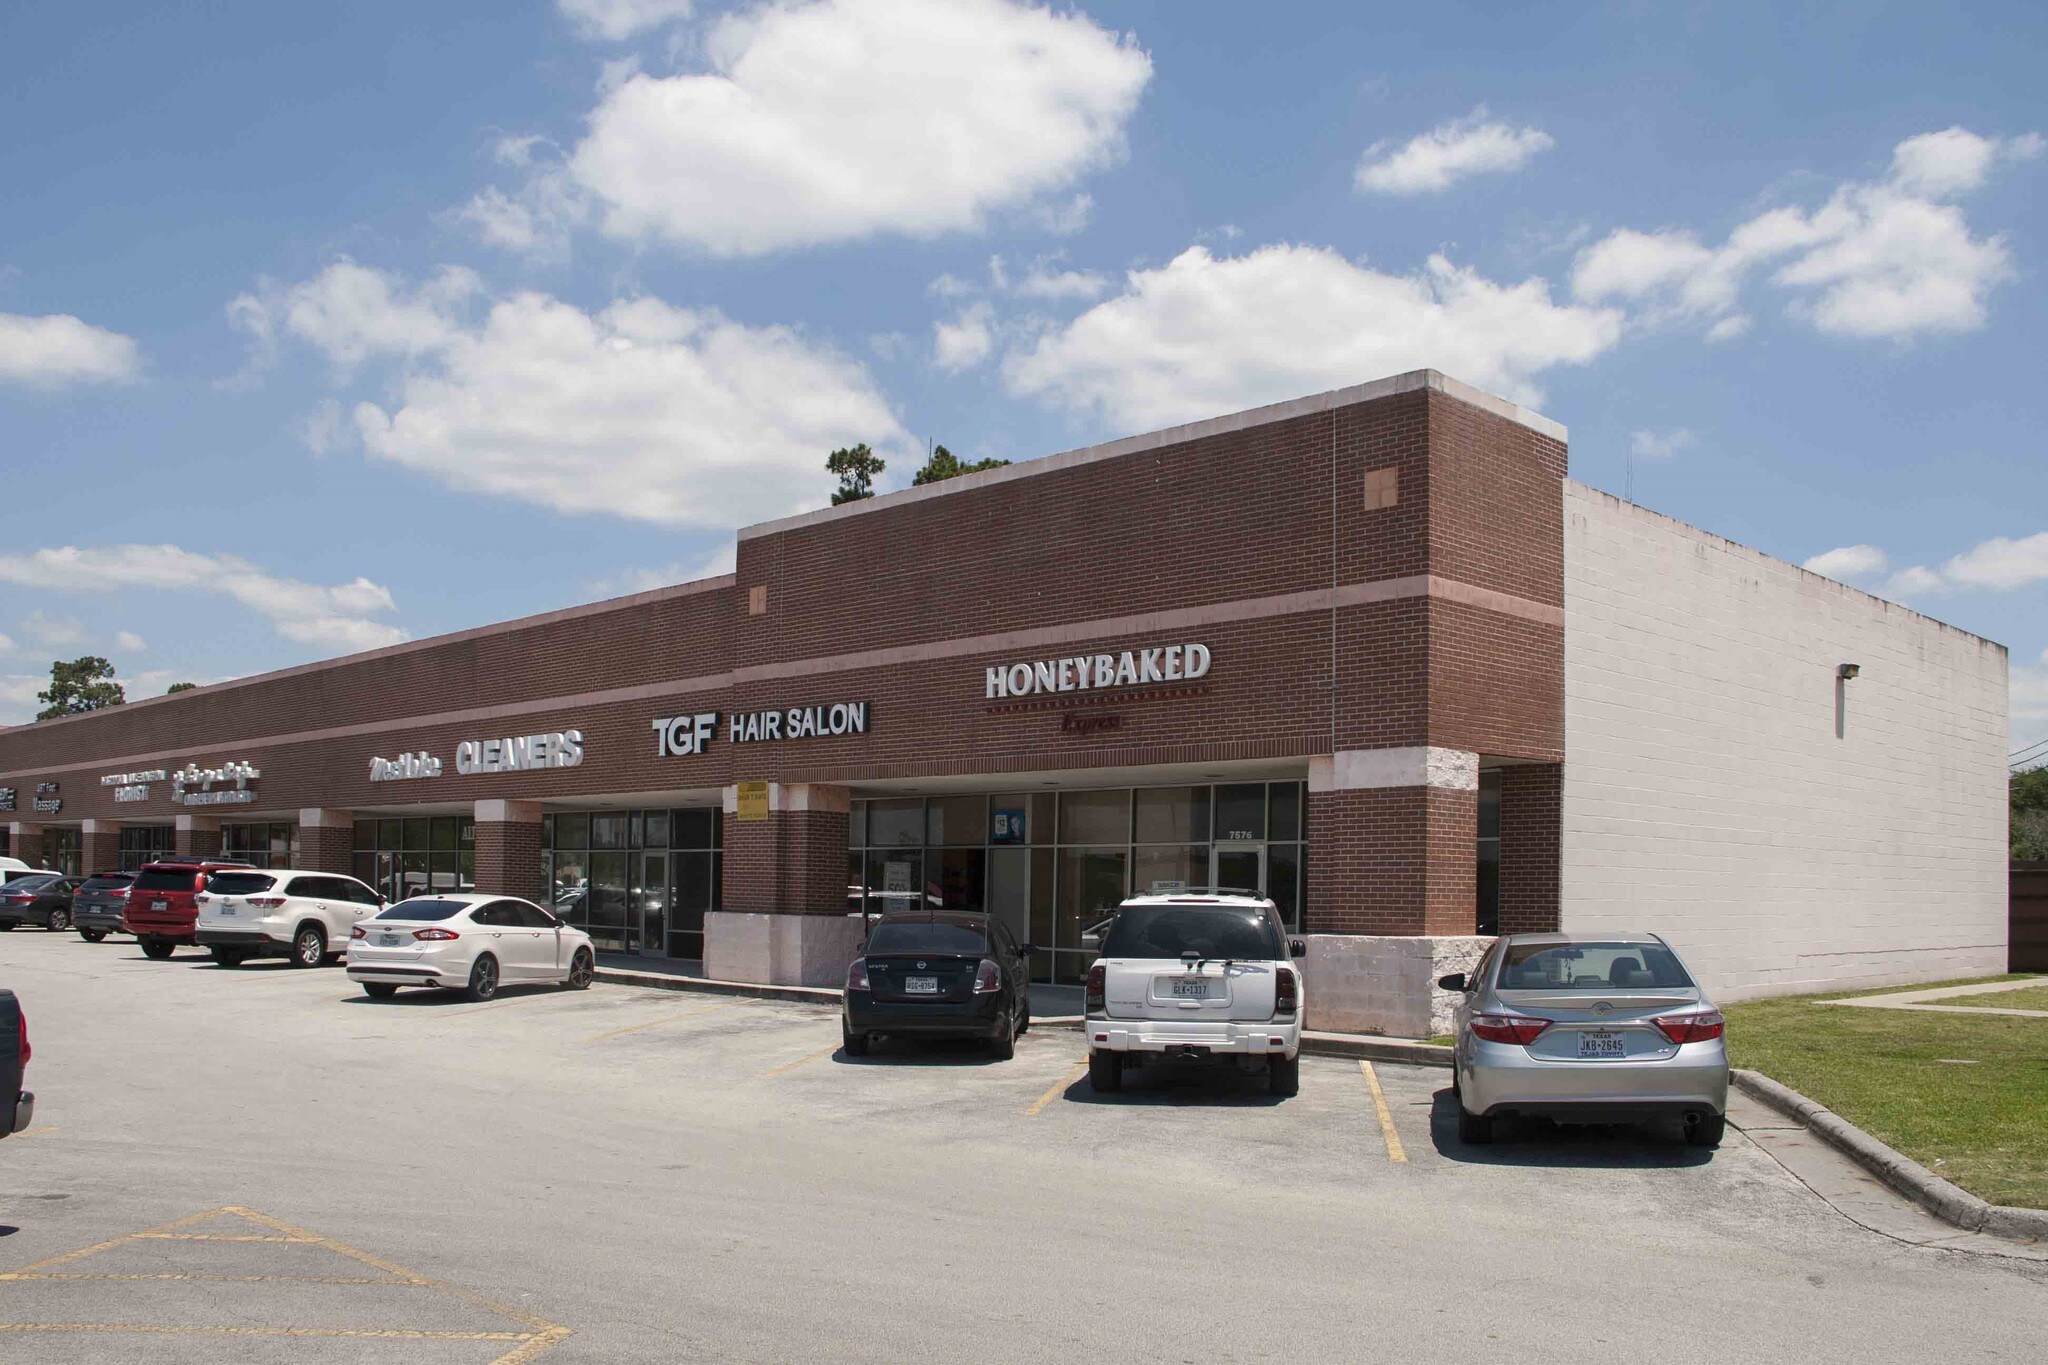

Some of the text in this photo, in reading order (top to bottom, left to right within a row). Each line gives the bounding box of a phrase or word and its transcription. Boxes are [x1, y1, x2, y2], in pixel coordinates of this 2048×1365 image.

[985, 643, 1212, 699] HONEYBAKED
[652, 702, 868, 758] TGF HAIR SALON
[455, 729, 584, 775] CLEANERS
[32, 796, 62, 815] Massage
[114, 785, 150, 802] FLORIST
[1228, 830, 1253, 840] 7576
